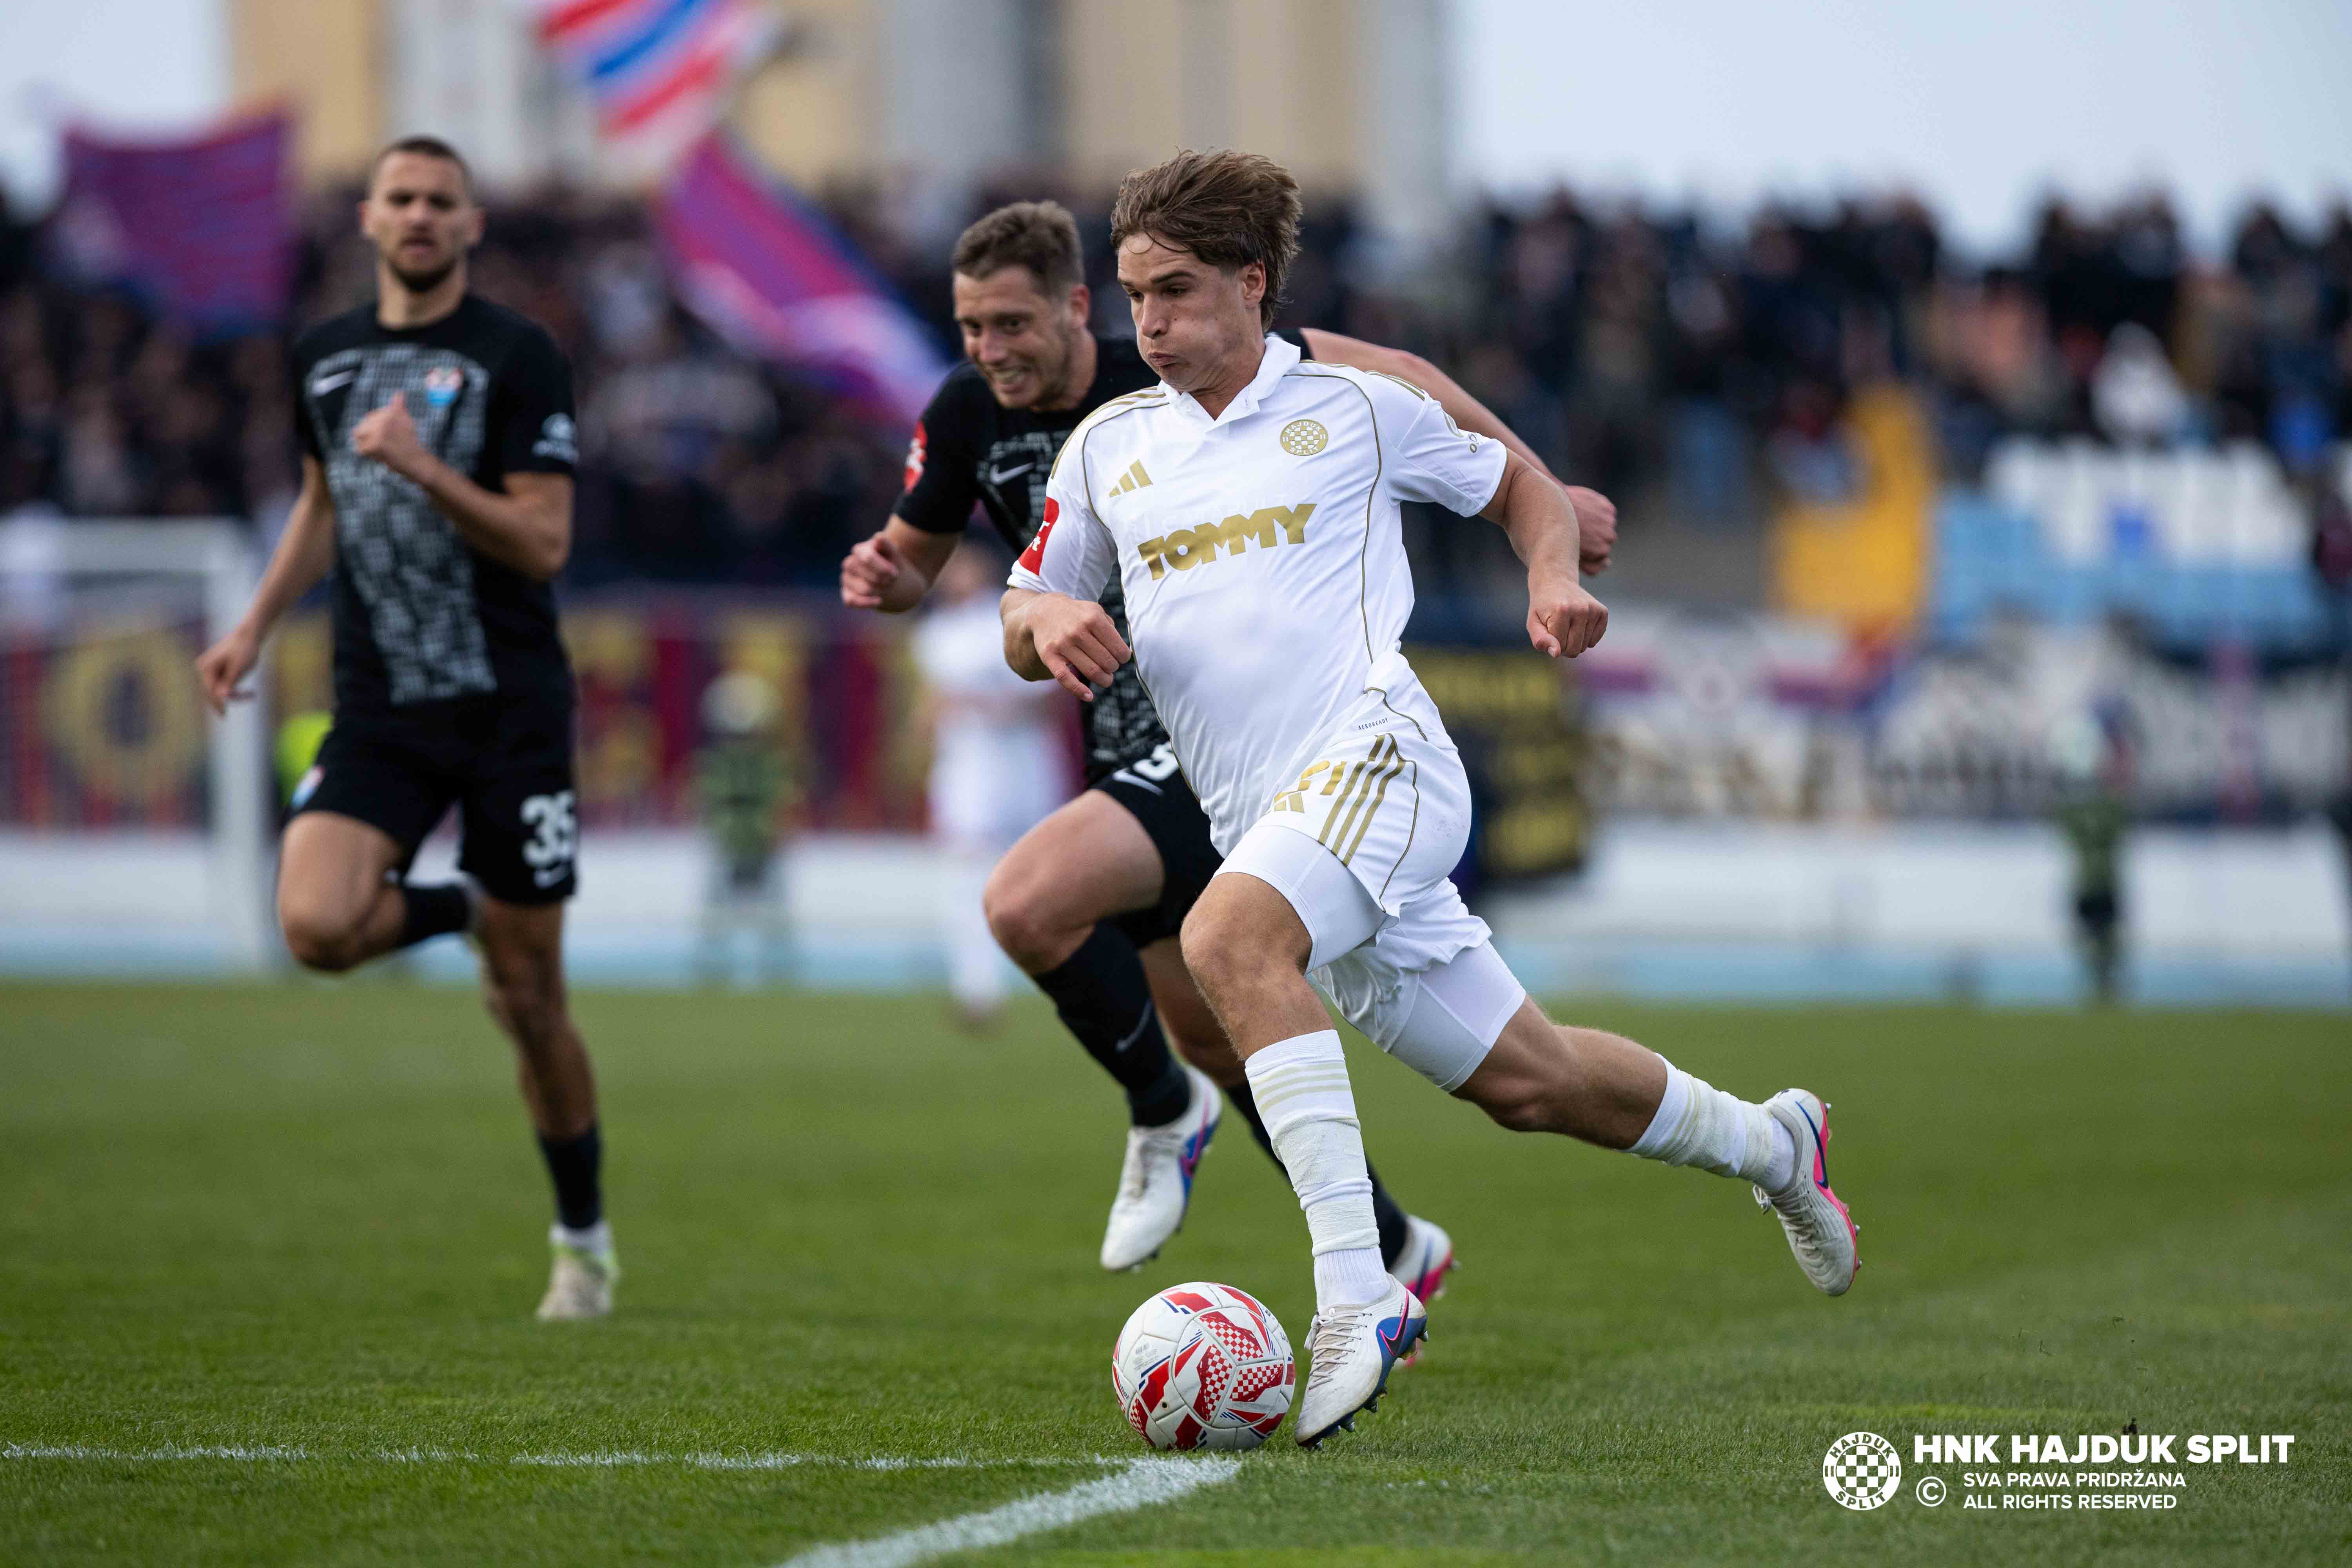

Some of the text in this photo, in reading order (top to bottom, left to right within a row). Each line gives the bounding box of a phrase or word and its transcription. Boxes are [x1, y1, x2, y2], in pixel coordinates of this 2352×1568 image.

[1285, 421, 1321, 433] HAJDUK
[1137, 503, 1318, 581] TOMMY
[1358, 718, 1388, 730] AEROREADY
